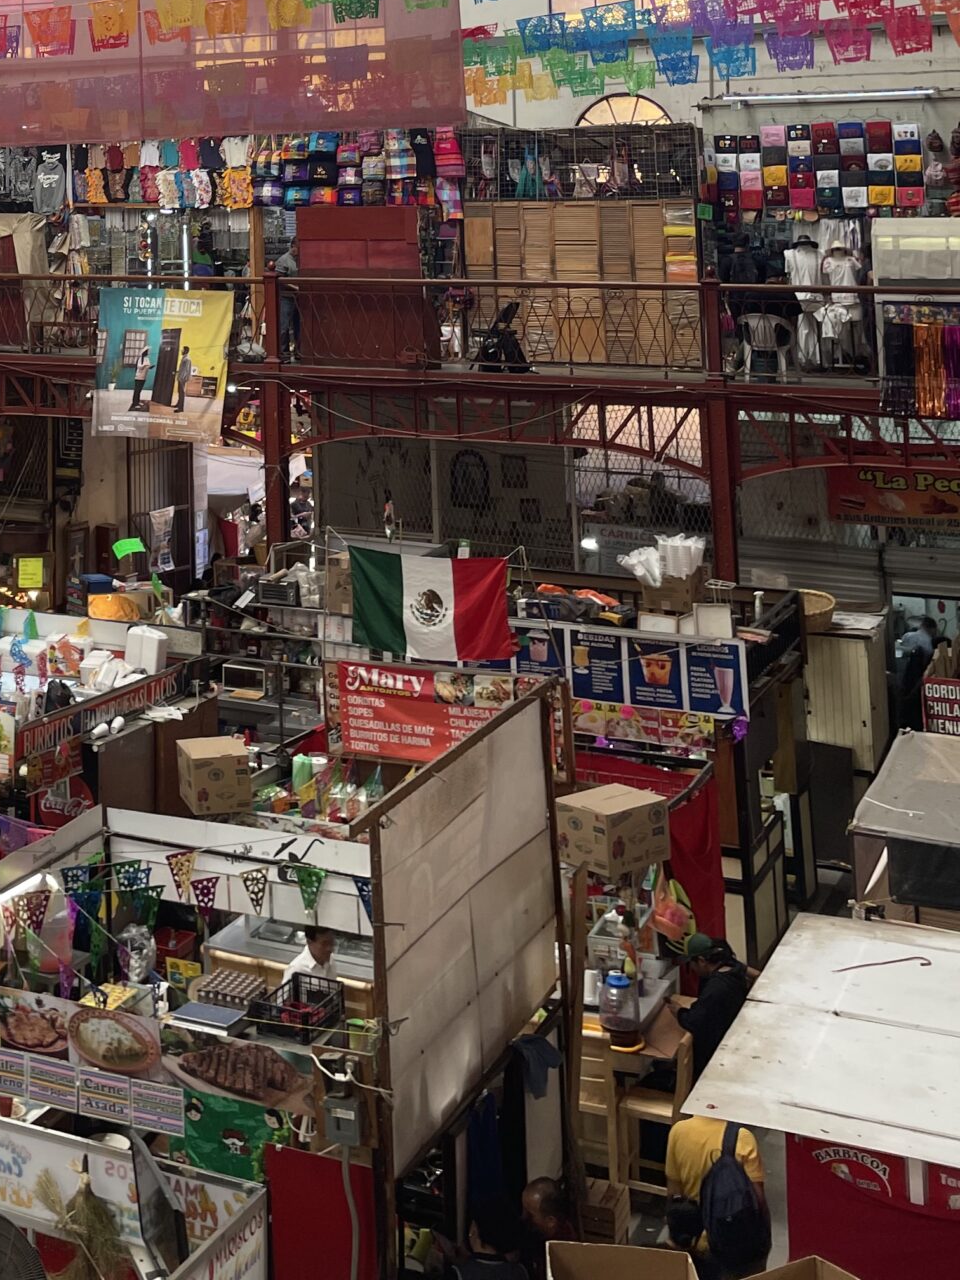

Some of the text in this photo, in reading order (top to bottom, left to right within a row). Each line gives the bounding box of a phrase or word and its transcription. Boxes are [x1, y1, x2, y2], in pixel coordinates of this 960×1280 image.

[124, 296, 162, 309] SI TOCAN
[165, 299, 201, 314] TE TOCA
[577, 632, 616, 644] BEBIDAS
[345, 666, 425, 698] Mary
[359, 685, 412, 697] ANTOJITOS
[347, 696, 386, 708] GORDITAS
[24, 715, 74, 756] BURRITOS
[151, 674, 178, 704] TACOS
[347, 707, 374, 718] SOPES
[448, 707, 491, 718] MILANESA
[349, 717, 401, 732] QUESADILLAS
[402, 724, 414, 734] DE
[350, 730, 432, 748] BURRITOS DE HARINA
[351, 741, 380, 753] TORTAS
[83, 1078, 124, 1096] Carne
[84, 1097, 125, 1115] Asada
[813, 1147, 890, 1179] BARBACOA
[214, 1208, 265, 1269] MARISCOS
